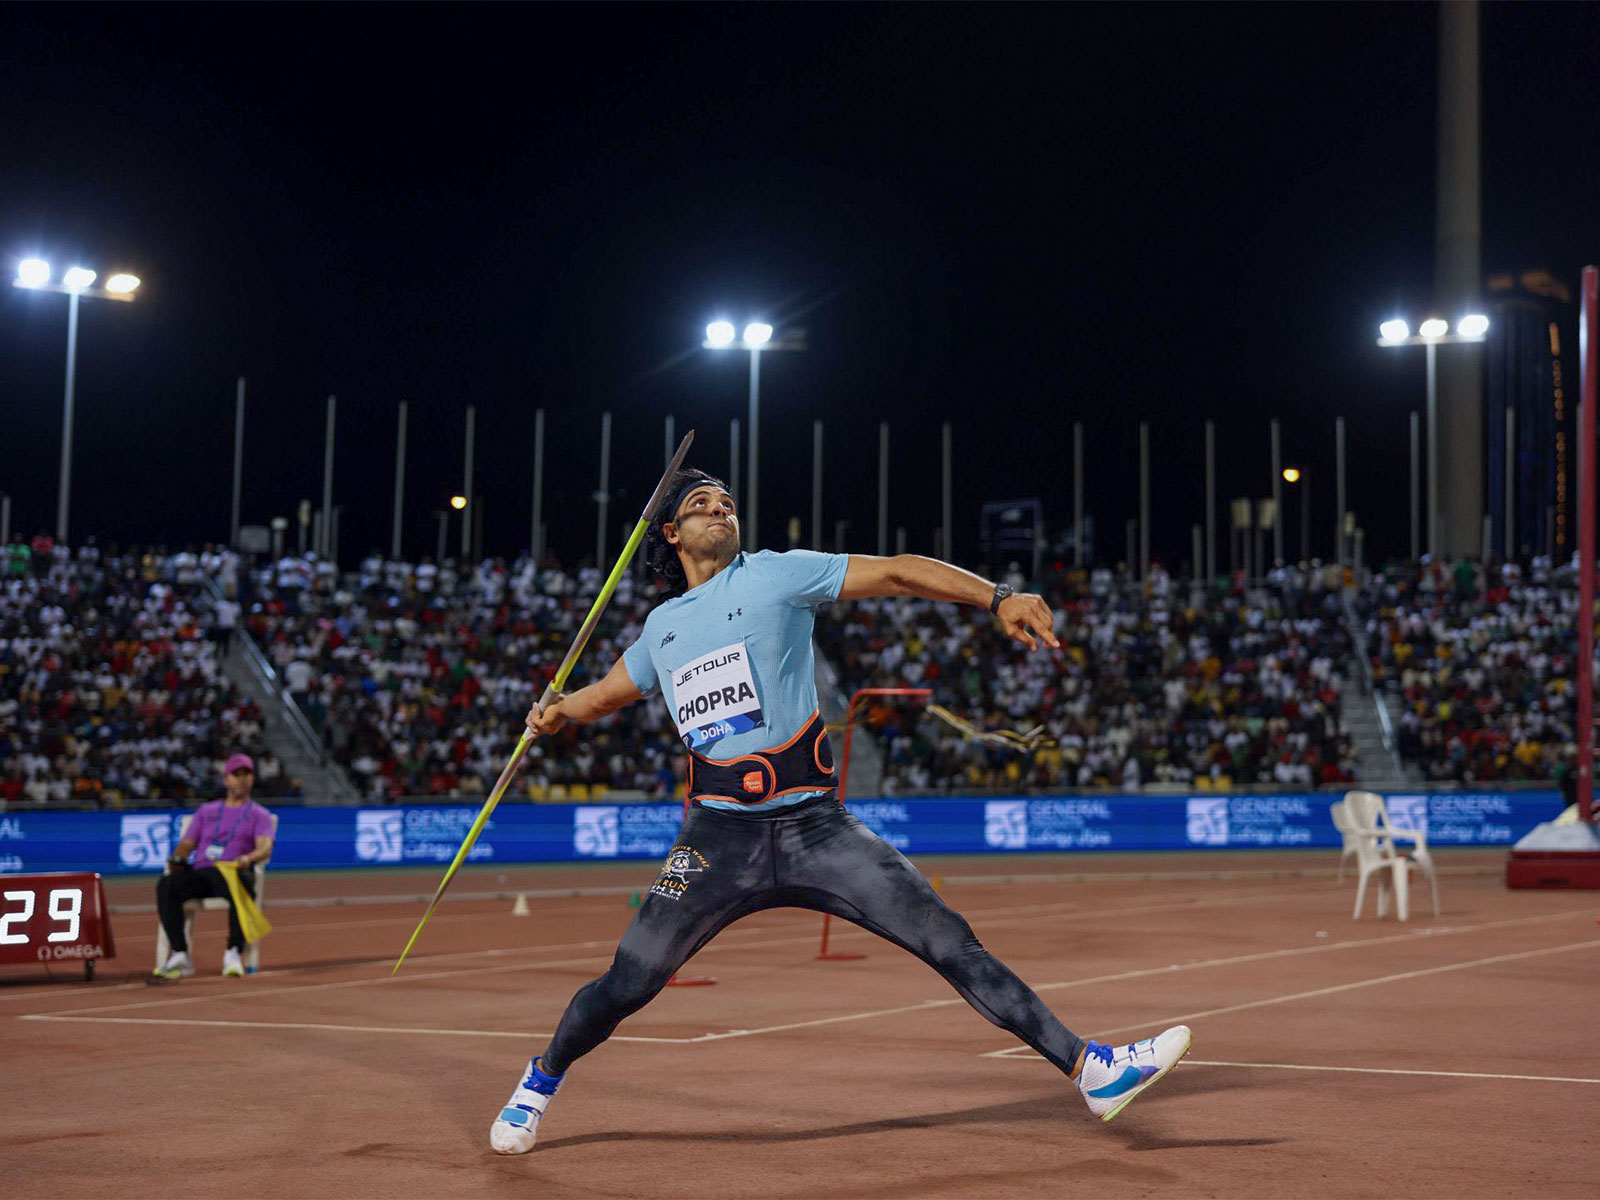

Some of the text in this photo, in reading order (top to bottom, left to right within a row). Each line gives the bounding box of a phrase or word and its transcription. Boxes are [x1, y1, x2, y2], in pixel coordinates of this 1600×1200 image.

[676, 651, 741, 687] JETOUR
[678, 681, 755, 725] CHOPRA
[701, 722, 735, 741] DOHA
[54, 944, 104, 959] OMEGA
